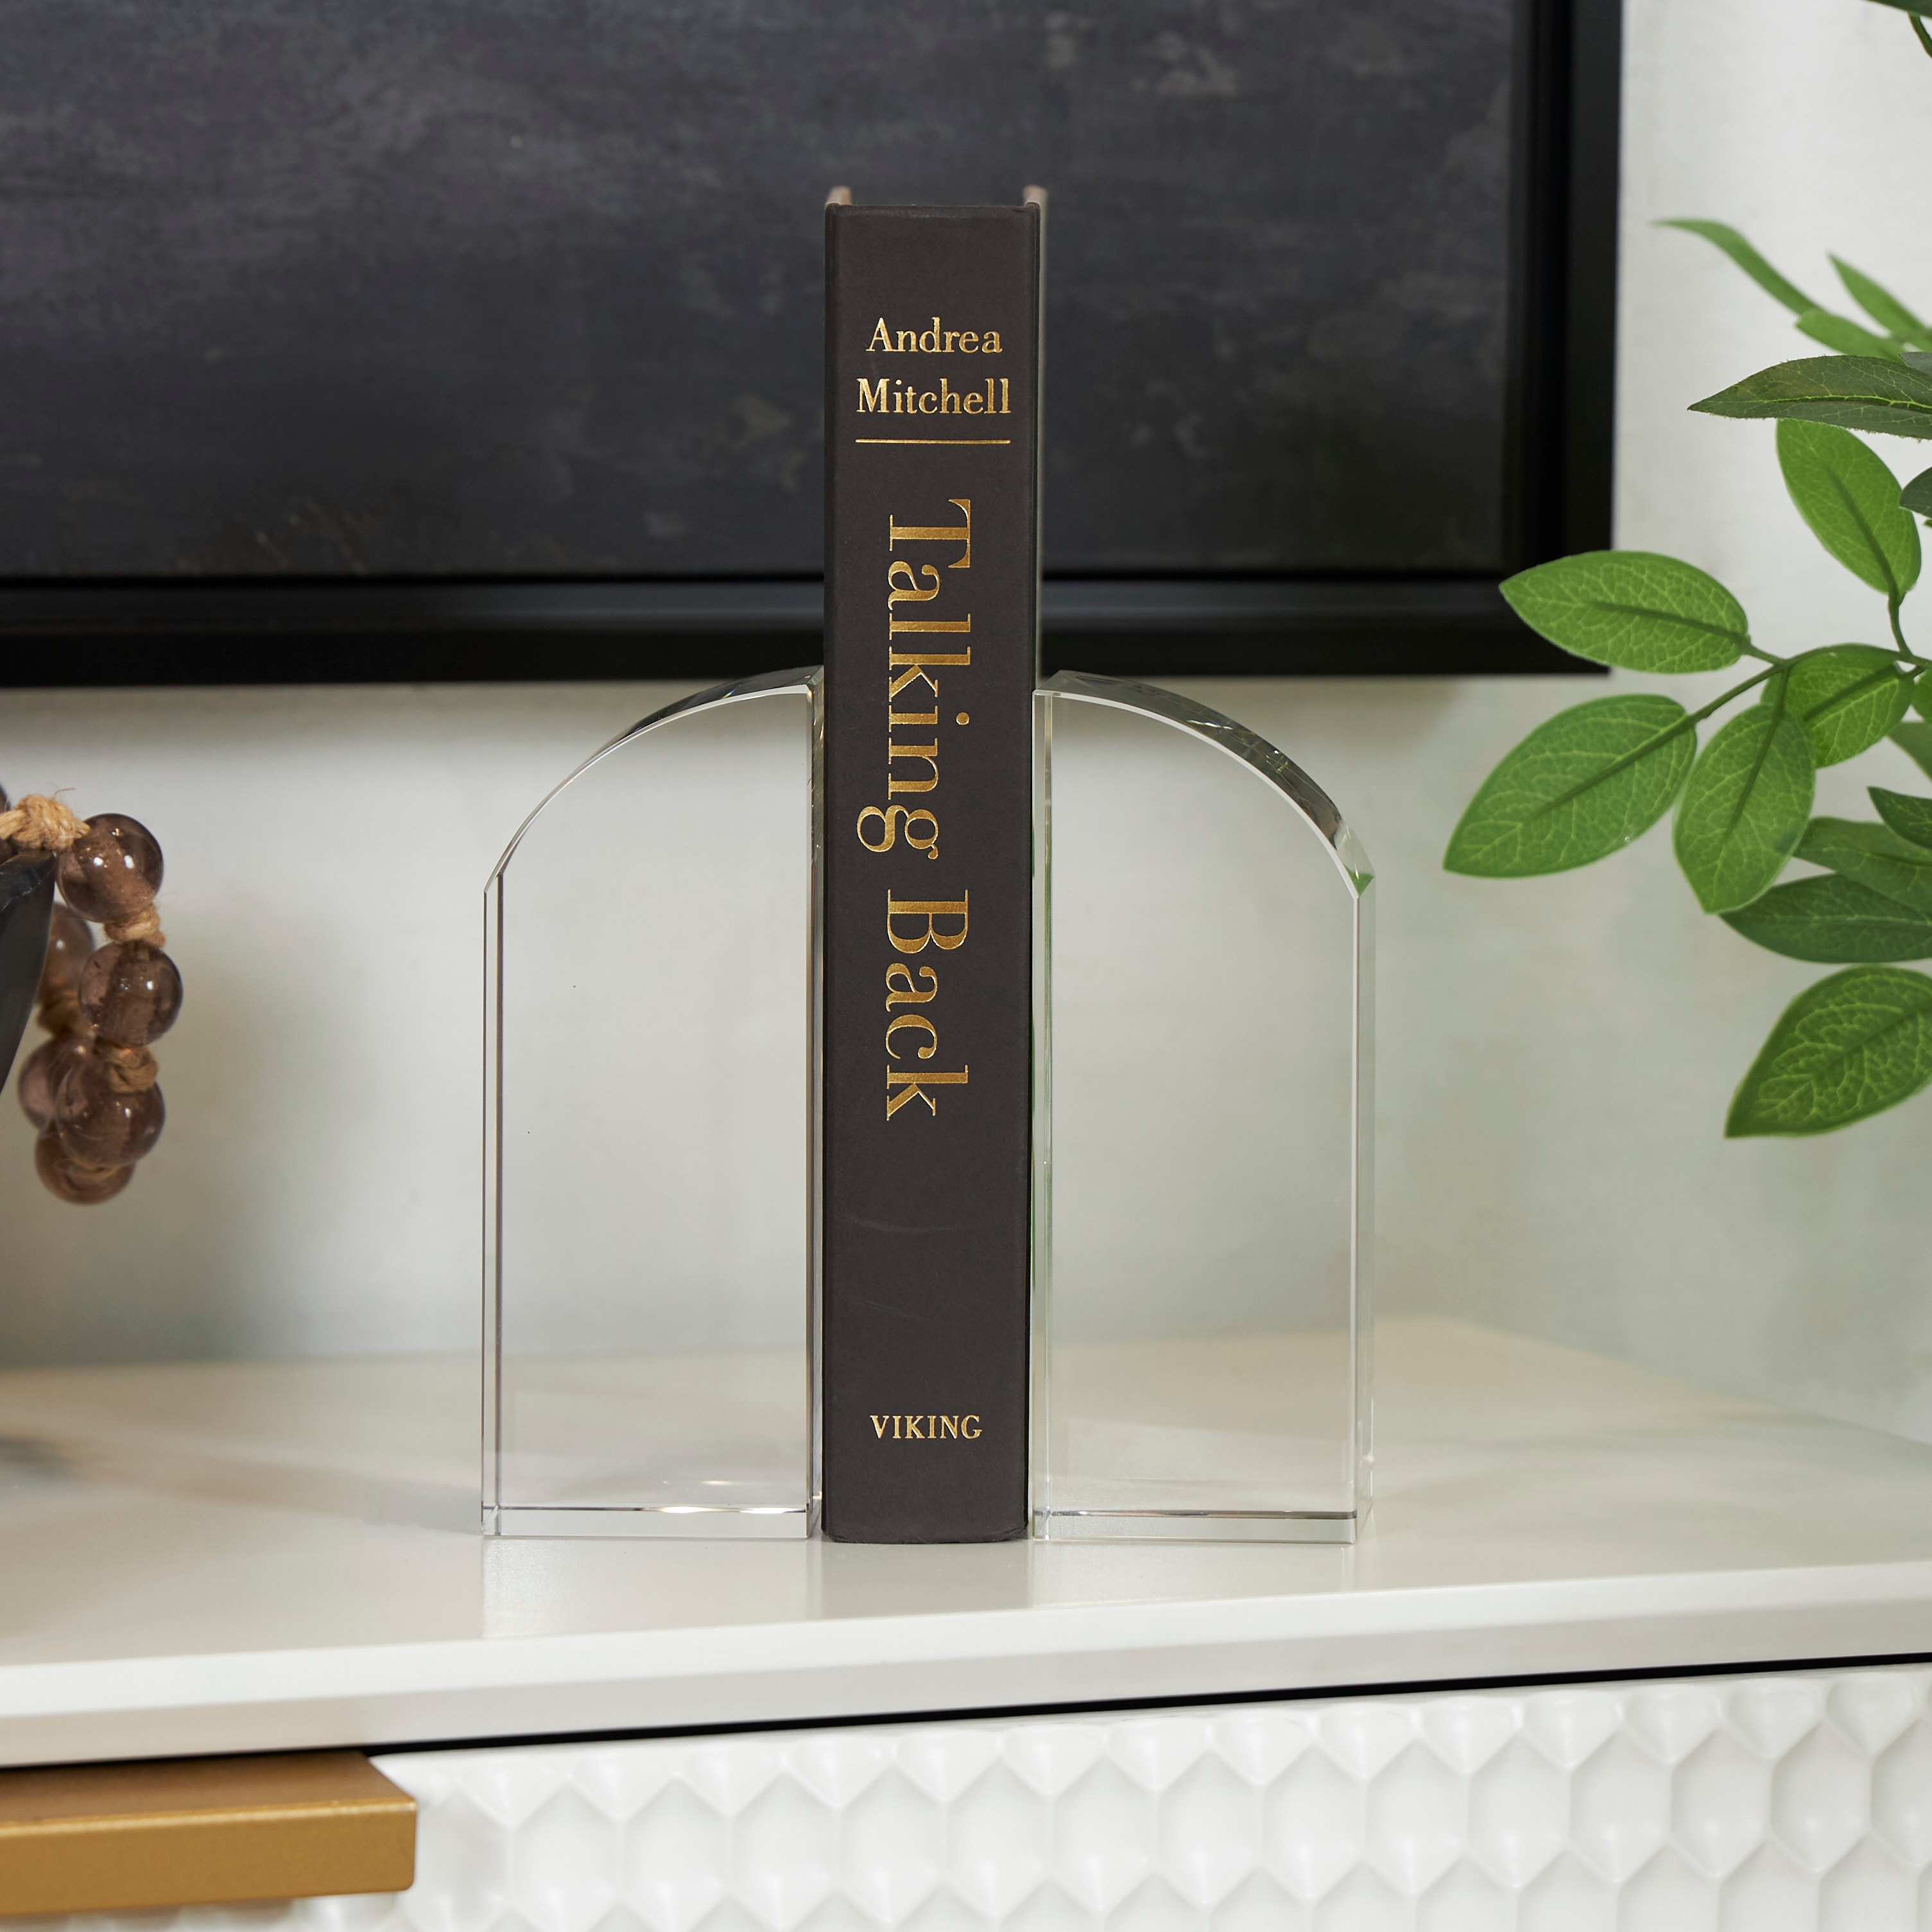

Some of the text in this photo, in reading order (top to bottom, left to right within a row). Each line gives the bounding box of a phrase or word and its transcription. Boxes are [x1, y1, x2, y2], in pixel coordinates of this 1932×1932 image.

[866, 316, 1003, 354] Andrea
[857, 377, 1012, 415] Mitchell
[856, 498, 971, 1121] Talking Back
[870, 1414, 983, 1440] VIKING
